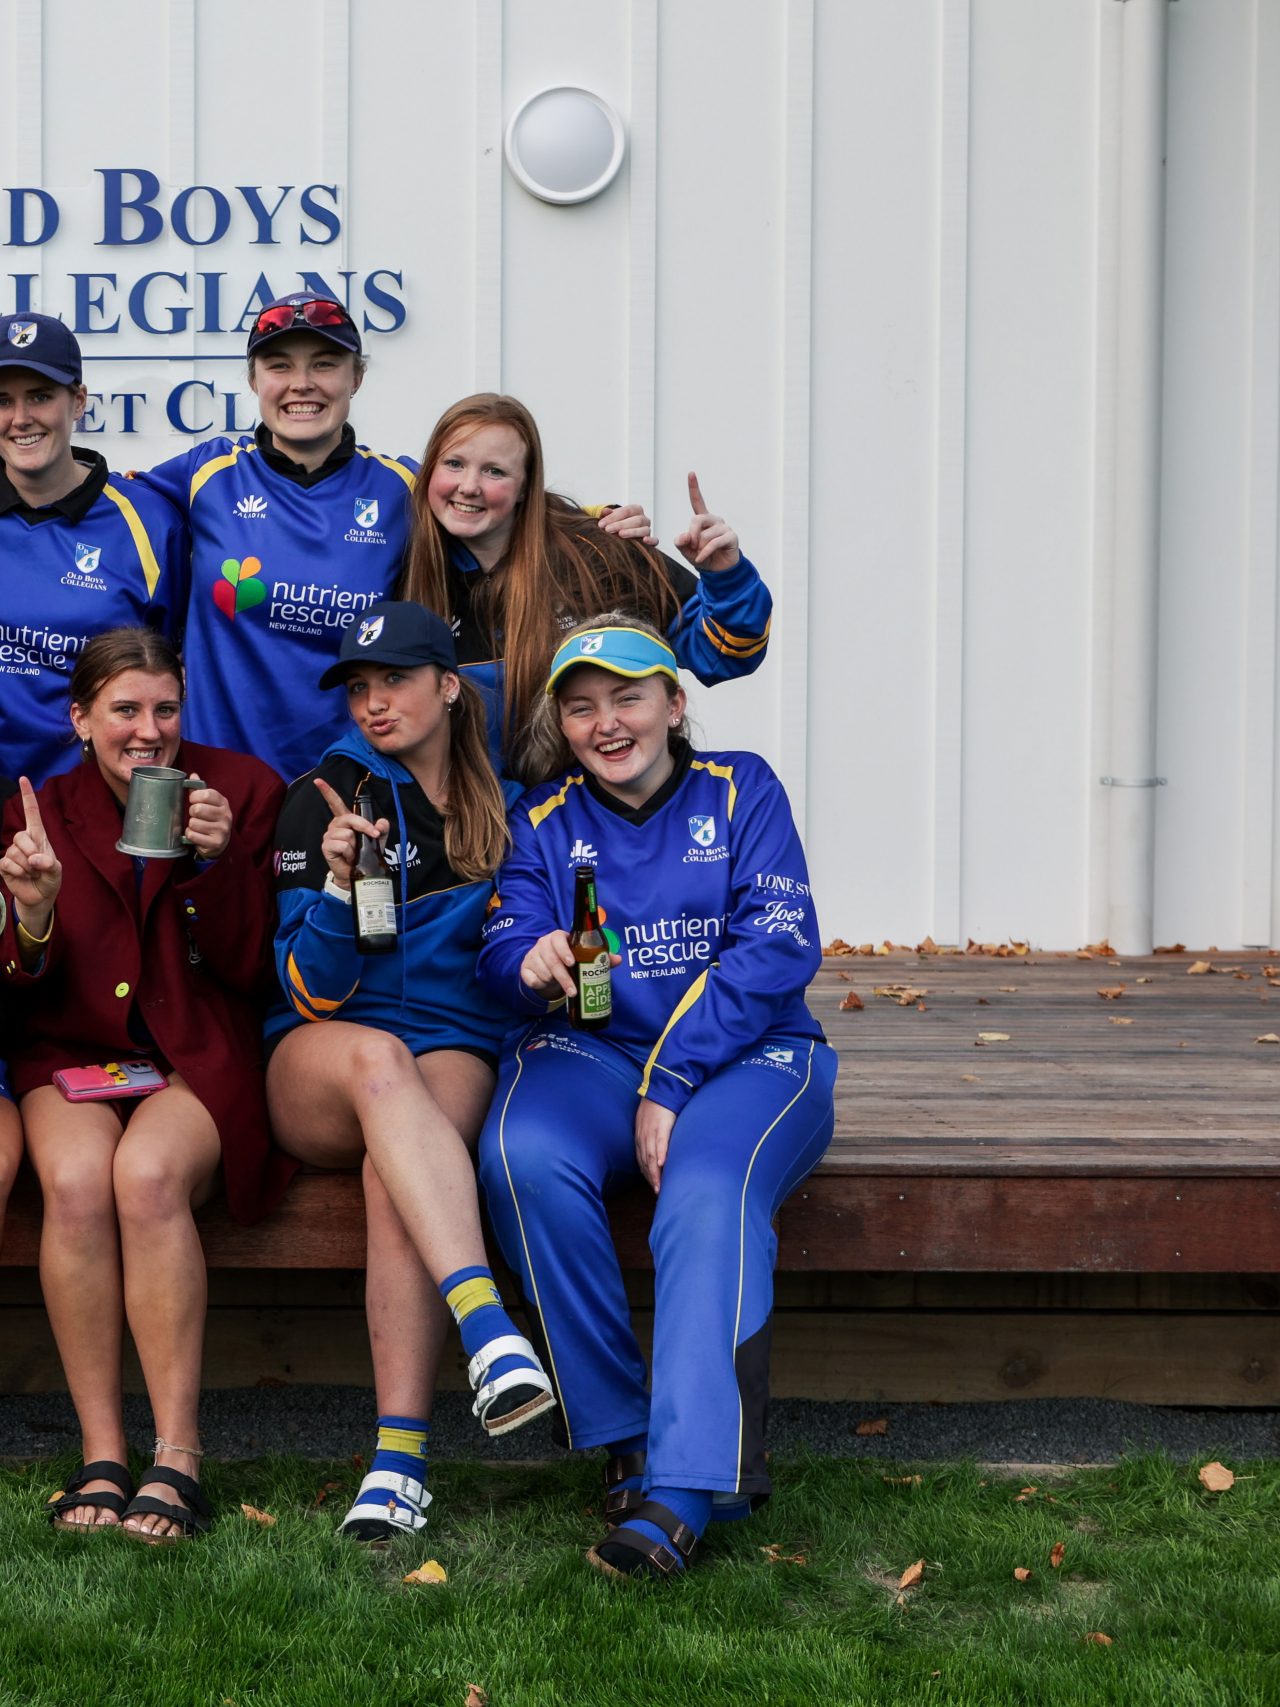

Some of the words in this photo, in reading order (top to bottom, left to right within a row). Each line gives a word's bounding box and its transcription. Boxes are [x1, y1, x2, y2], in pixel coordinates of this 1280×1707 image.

[93, 168, 341, 246] BOYS
[166, 380, 256, 434] CL
[232, 510, 267, 519] PALADIN
[349, 528, 365, 537] OLD
[366, 529, 384, 538] BOYS
[60, 576, 108, 592] COLLEGIANS
[66, 571, 83, 581] OLD
[84, 574, 105, 585] BOYS
[272, 580, 379, 611] nutrient
[270, 600, 355, 629] rescue
[268, 621, 287, 631] NEW
[287, 622, 323, 636] ZEALAND
[6, 665, 41, 676] ZEALAND
[756, 873, 795, 894] LONE
[795, 881, 810, 898] ST
[753, 900, 806, 926] Joe's
[623, 912, 727, 944] nutrient
[627, 939, 711, 968] rescue
[630, 969, 650, 980] NEW
[650, 966, 687, 979] ZEALAND
